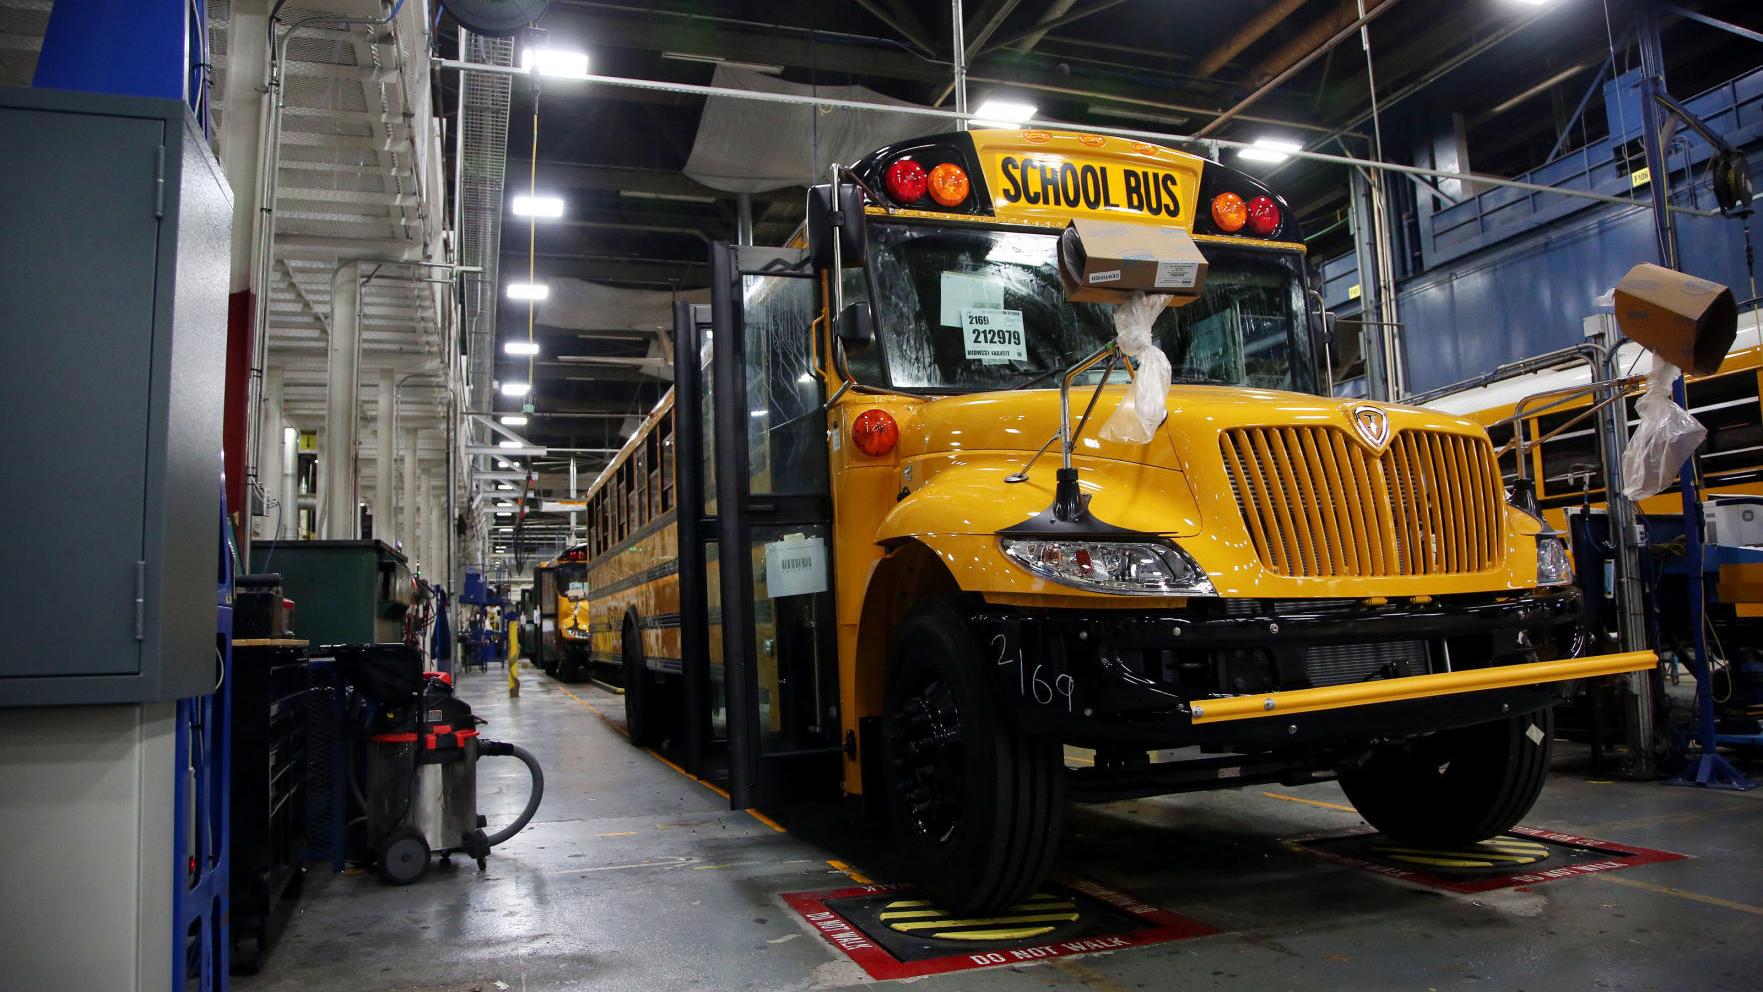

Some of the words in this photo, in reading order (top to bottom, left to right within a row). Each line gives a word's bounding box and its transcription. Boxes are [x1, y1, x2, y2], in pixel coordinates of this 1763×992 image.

[1001, 156, 1119, 210] SCHOOL
[1123, 168, 1180, 218] BUS
[968, 315, 989, 325] 2169
[972, 329, 1021, 345] 212979
[990, 633, 1074, 713] 2169
[816, 919, 851, 932] NOT
[831, 931, 873, 951] WALK
[968, 952, 1007, 965] DO
[1010, 945, 1059, 960] NOT
[1061, 936, 1132, 952] WALK
